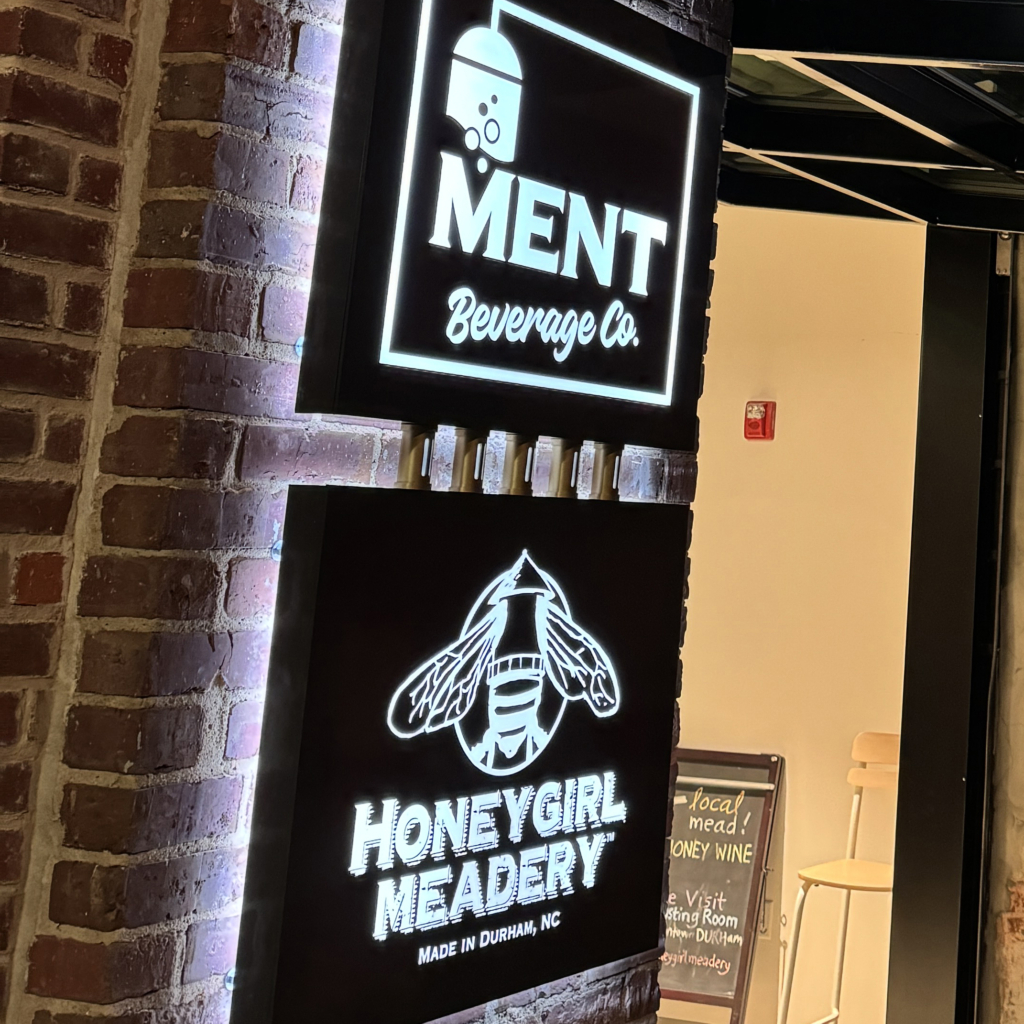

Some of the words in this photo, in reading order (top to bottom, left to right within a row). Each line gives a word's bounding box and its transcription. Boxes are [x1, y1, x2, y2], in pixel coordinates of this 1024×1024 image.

[428, 151, 668, 297] MENT
[445, 286, 597, 362] Beverage
[600, 300, 640, 348] Co.
[689, 787, 745, 815] local
[348, 772, 627, 876] HONEYGIRL
[716, 842, 752, 863] WINE
[372, 833, 605, 941] MEADERY
[686, 890, 727, 911] Visit
[541, 911, 561, 930] NC
[702, 908, 738, 929] Room
